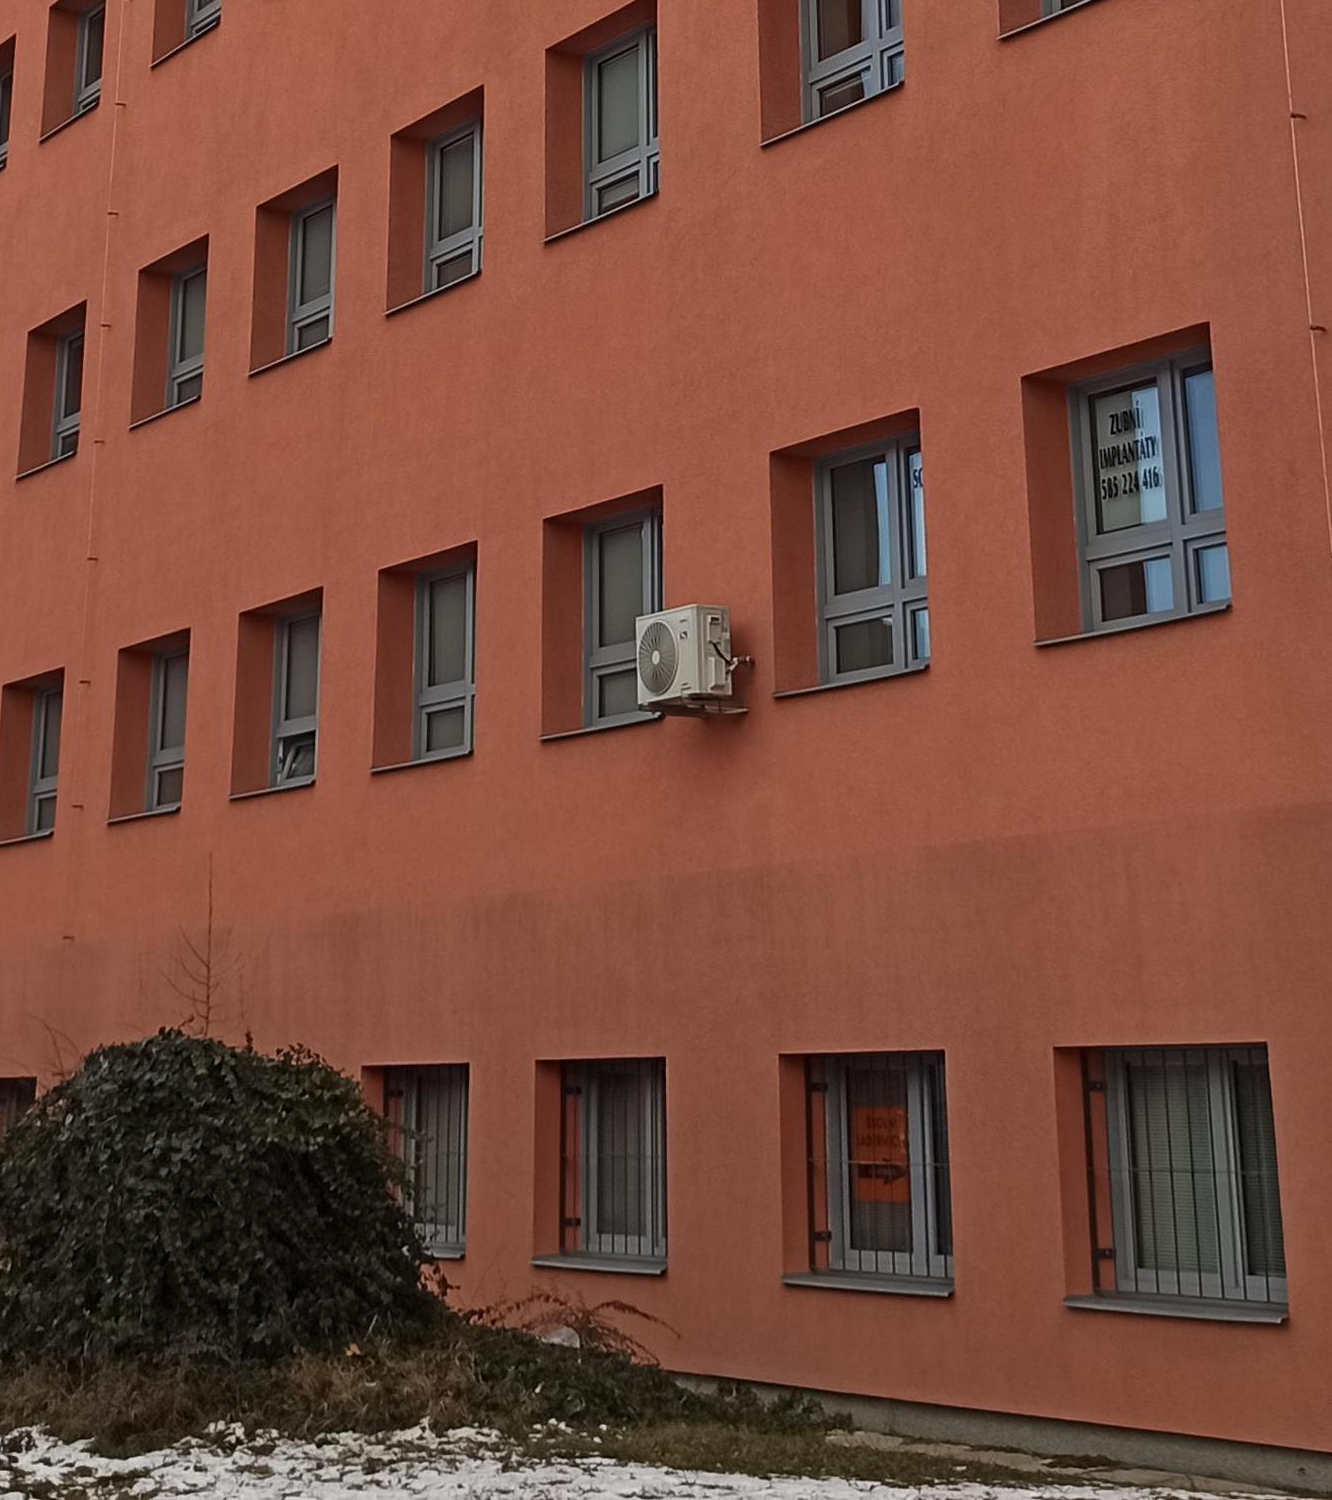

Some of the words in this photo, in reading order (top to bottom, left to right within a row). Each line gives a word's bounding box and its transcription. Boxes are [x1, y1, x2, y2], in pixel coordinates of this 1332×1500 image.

[1109, 400, 1142, 435] ZUBNÍ
[1099, 431, 1157, 470] IMPLANTÁTY
[1101, 476, 1119, 500] 585
[1122, 470, 1140, 495] 224
[1142, 466, 1160, 490] 416
